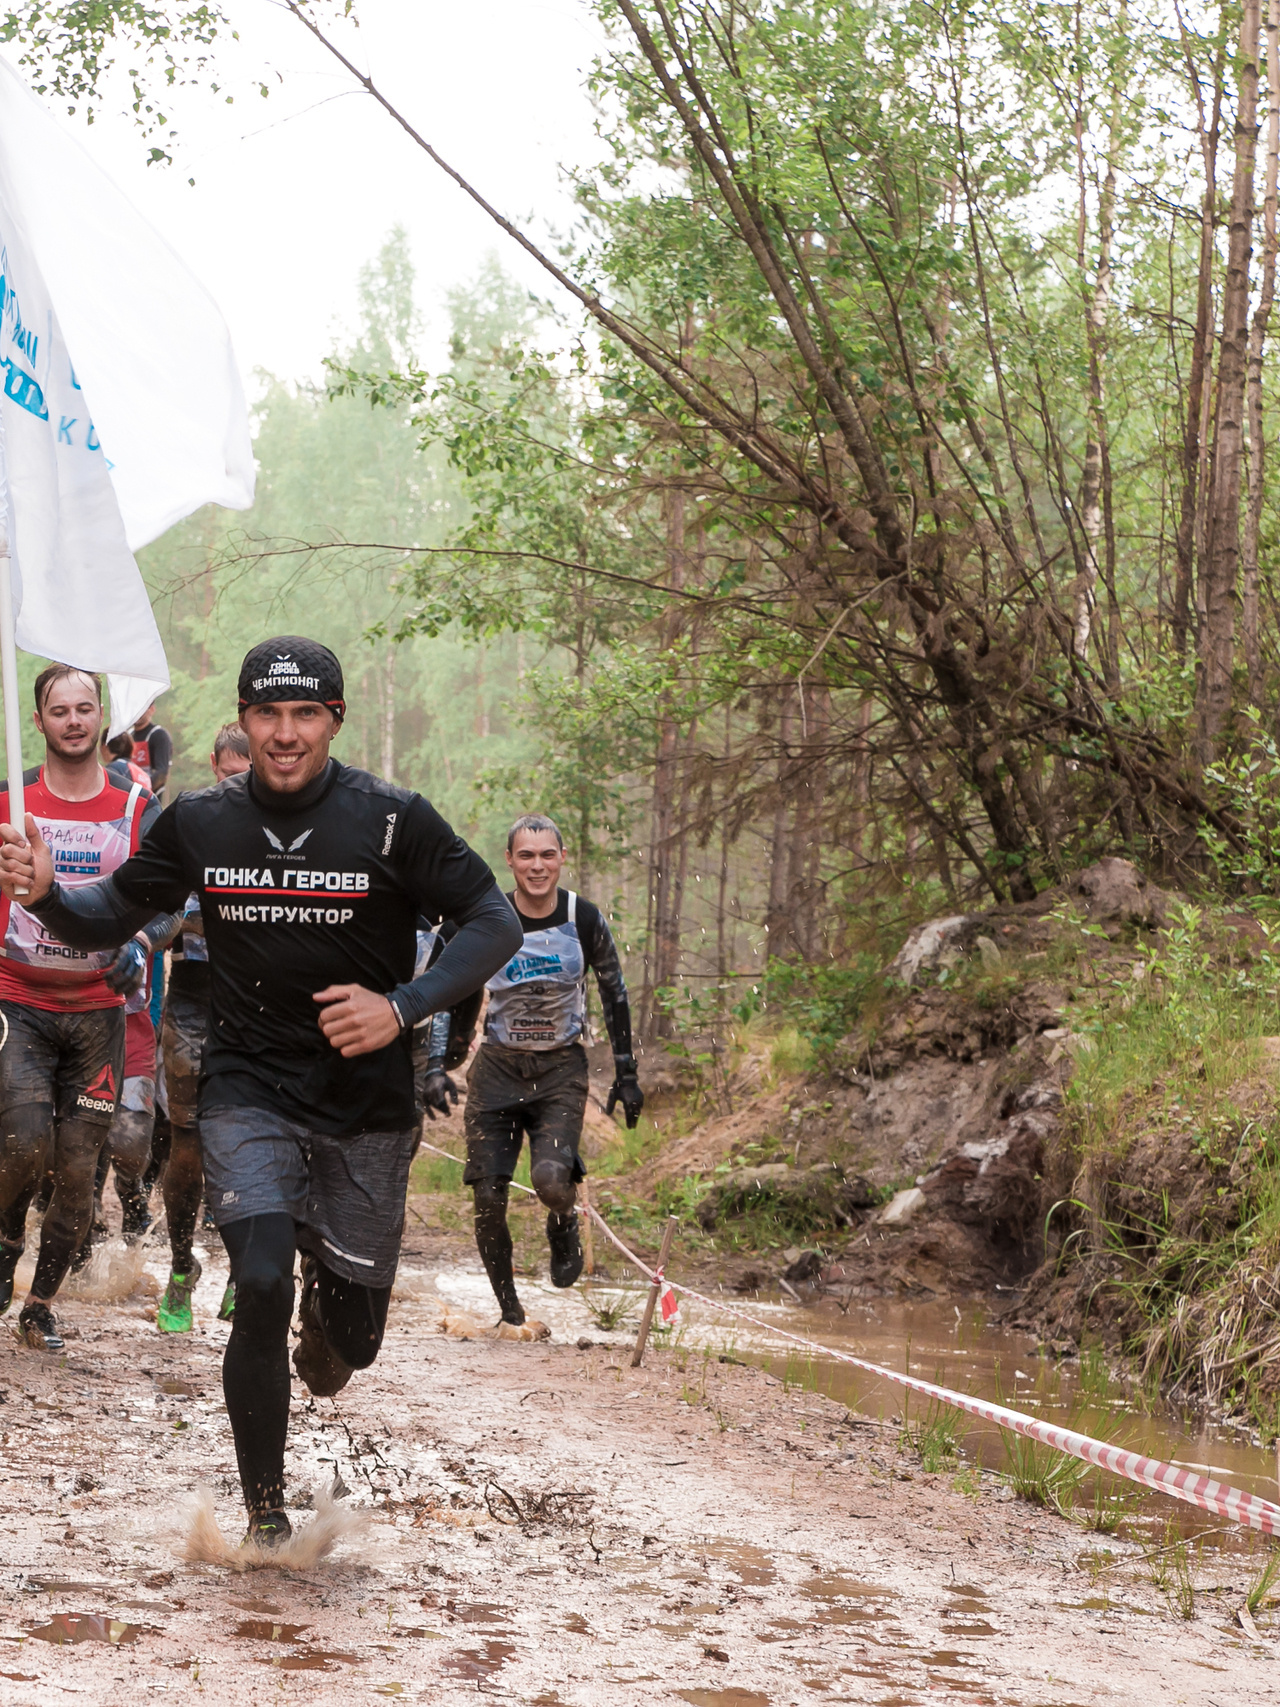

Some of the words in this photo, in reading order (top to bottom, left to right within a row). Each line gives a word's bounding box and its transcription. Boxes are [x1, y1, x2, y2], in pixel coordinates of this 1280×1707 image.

[268, 668, 300, 676] ГЕРОЕВ
[252, 676, 320, 691] ЧЕМПИОНАТ
[381, 823, 395, 856] Reebok
[55, 850, 101, 863] ГАЗПРОМ
[204, 867, 275, 887] ГОНКА
[282, 870, 369, 891] ГЕРОЕВ
[218, 905, 353, 924] ИНСТРУКТОР
[36, 944, 88, 959] ГЕРОЕВ
[513, 1019, 553, 1027] ГОНКА
[509, 1032, 556, 1041] ГЕРОЕВ
[77, 1095, 114, 1113] Reebo
